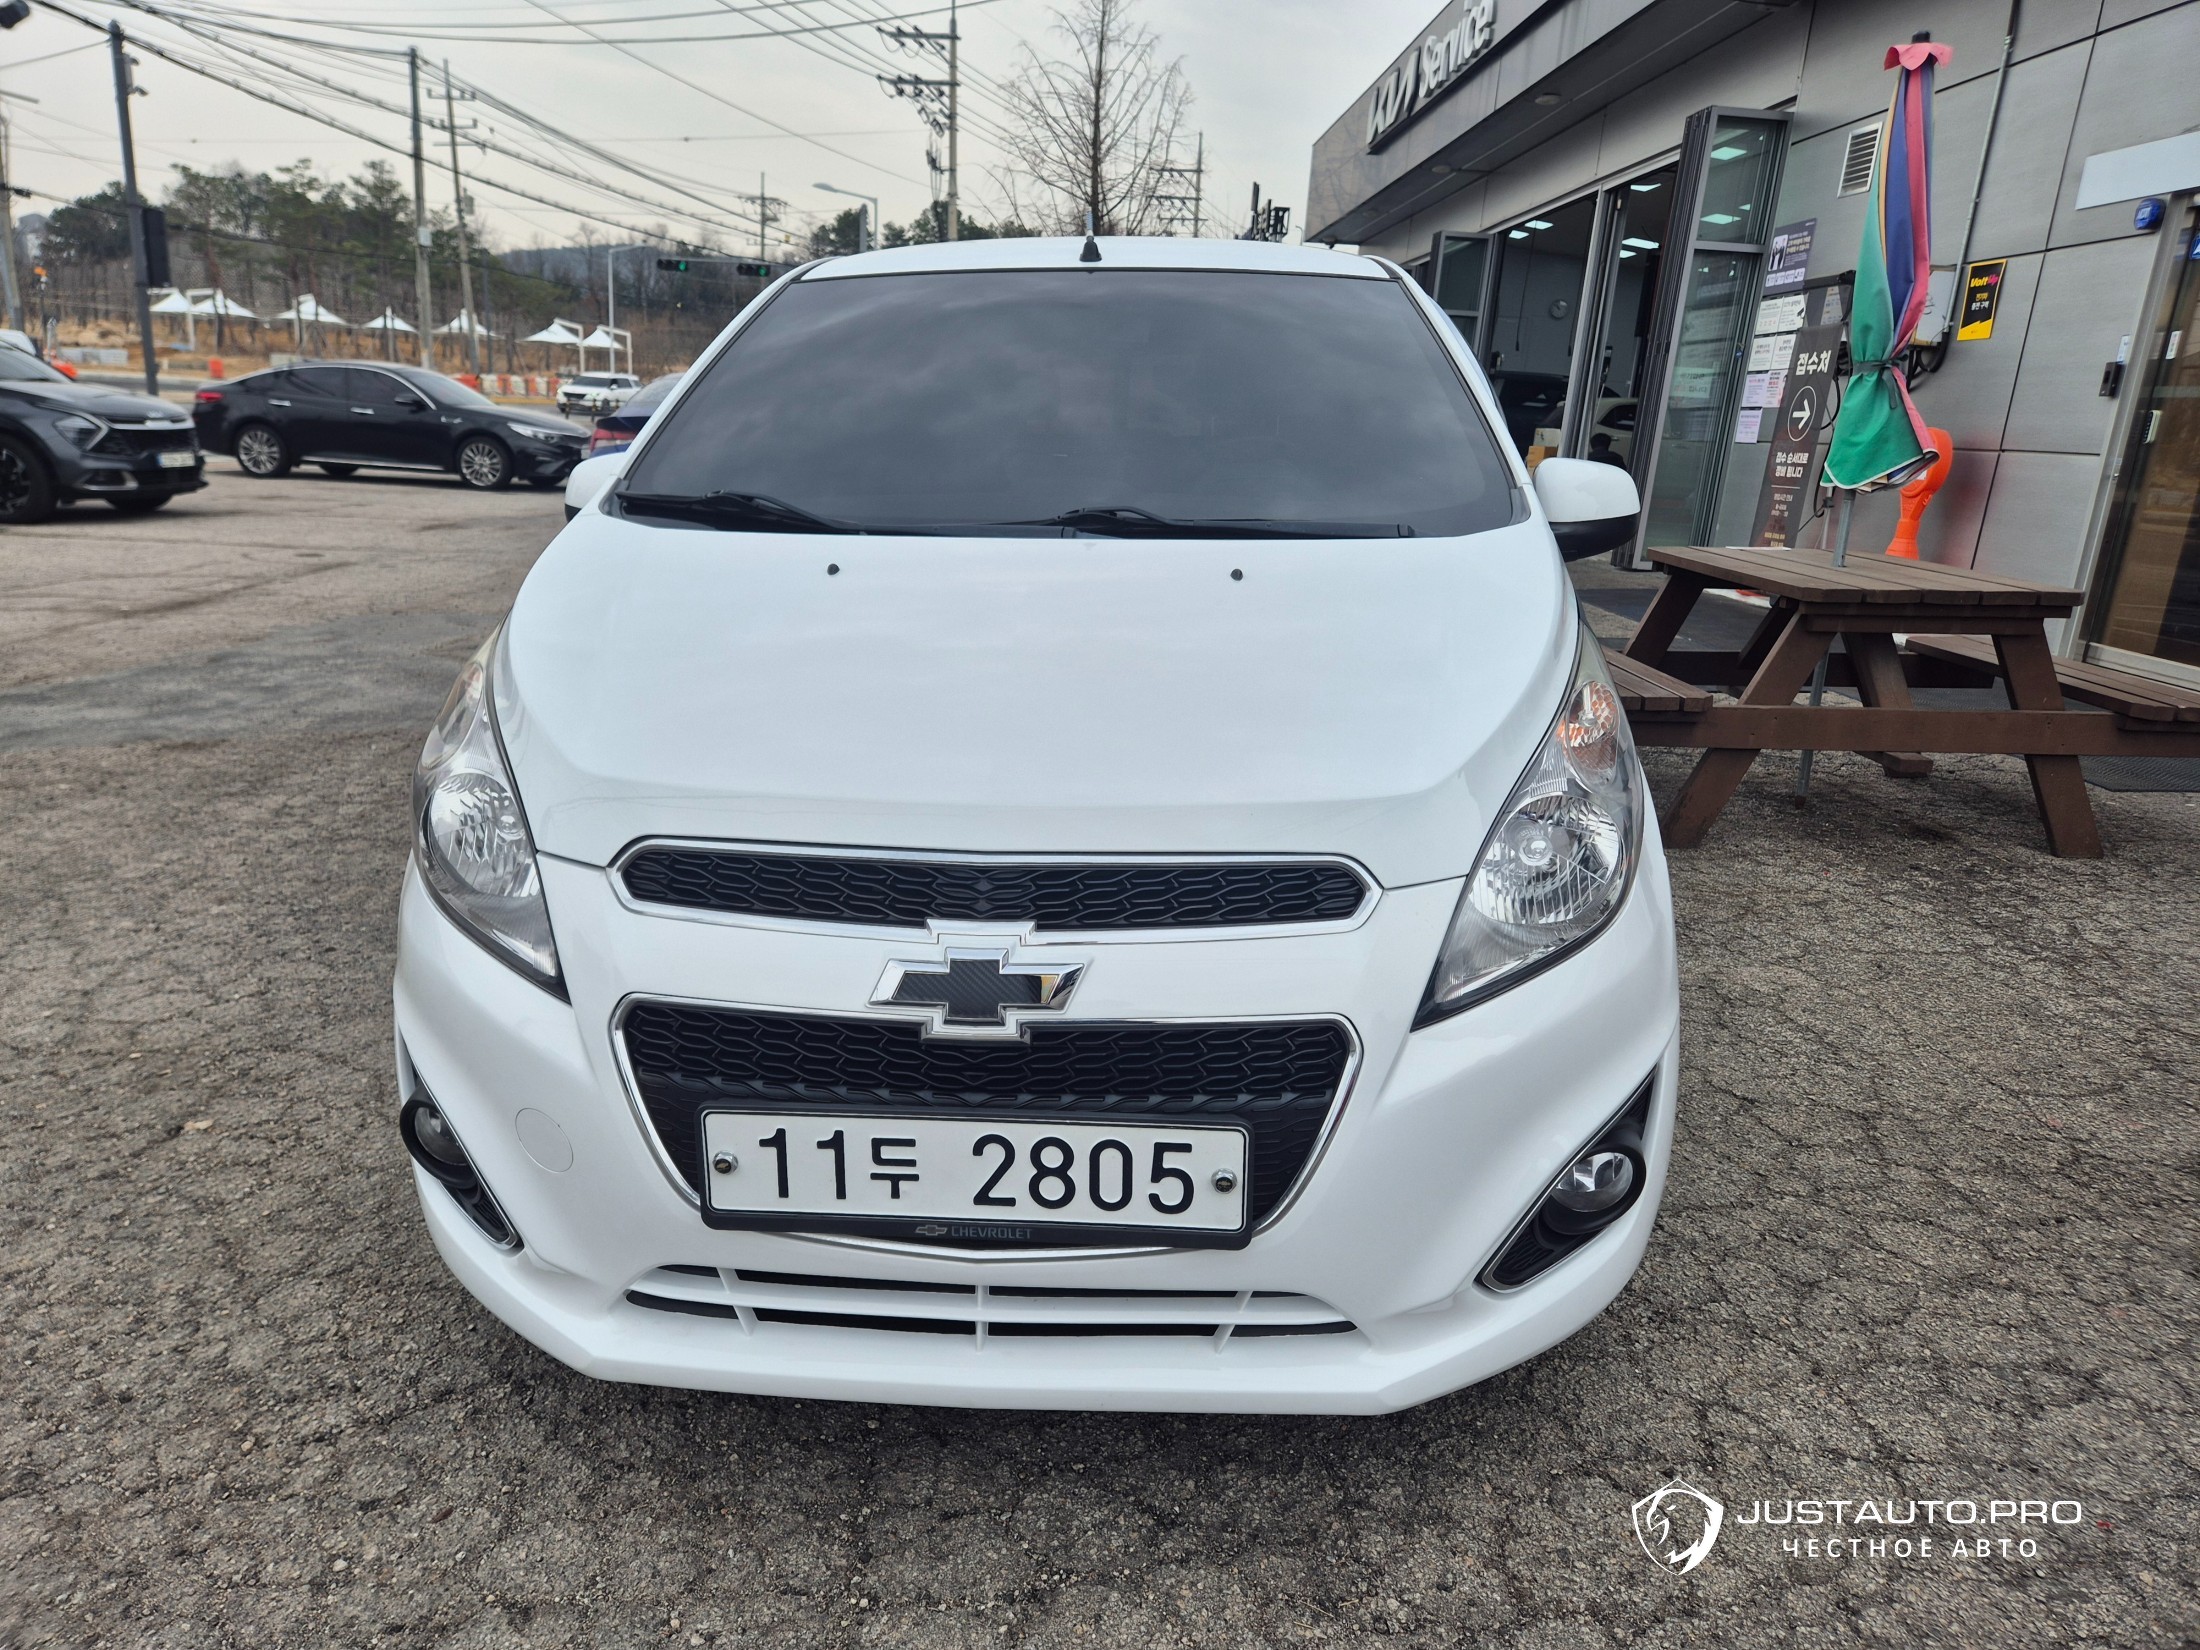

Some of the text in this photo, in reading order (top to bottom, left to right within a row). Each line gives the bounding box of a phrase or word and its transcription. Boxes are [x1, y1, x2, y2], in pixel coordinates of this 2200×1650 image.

[1419, 0, 1493, 98] Service
[1796, 350, 1831, 375] 접수처
[1776, 452, 1787, 464] 접수
[759, 1128, 1195, 1214] 11두 2805
[951, 1226, 1033, 1239] CHEVROLET
